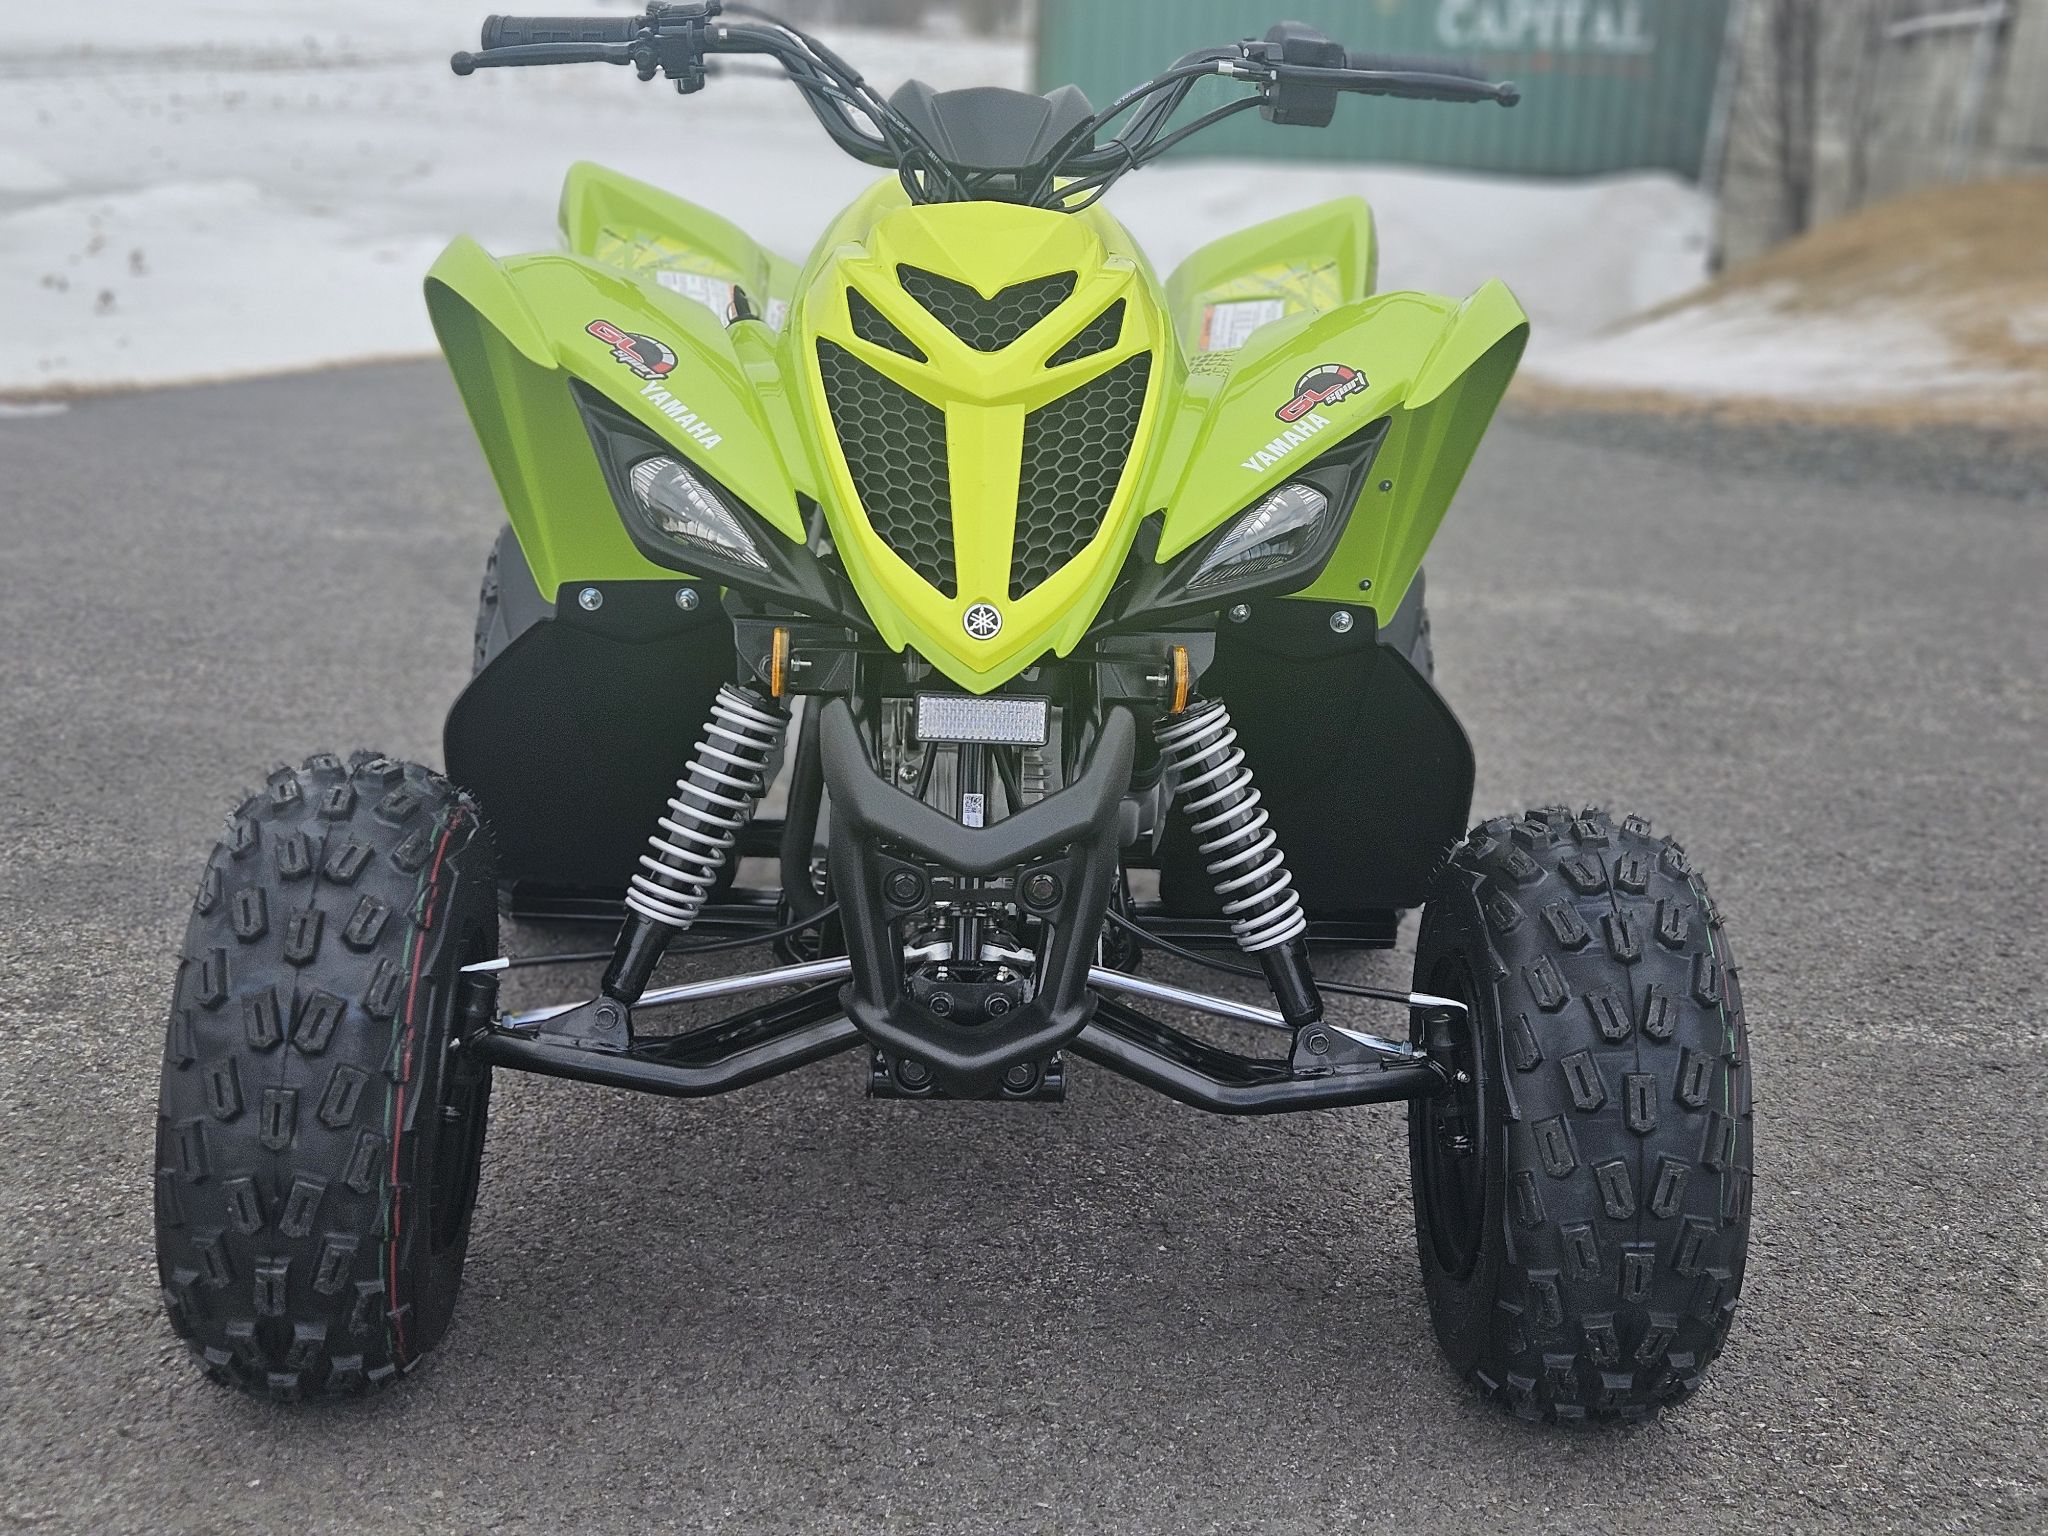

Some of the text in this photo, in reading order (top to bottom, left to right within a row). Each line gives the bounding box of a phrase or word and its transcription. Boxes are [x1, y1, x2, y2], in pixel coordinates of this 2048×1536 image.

[1436, 0, 1656, 54] CAPITAL
[639, 379, 723, 450] YAMAHA
[1240, 411, 1331, 473] YAMAHA
